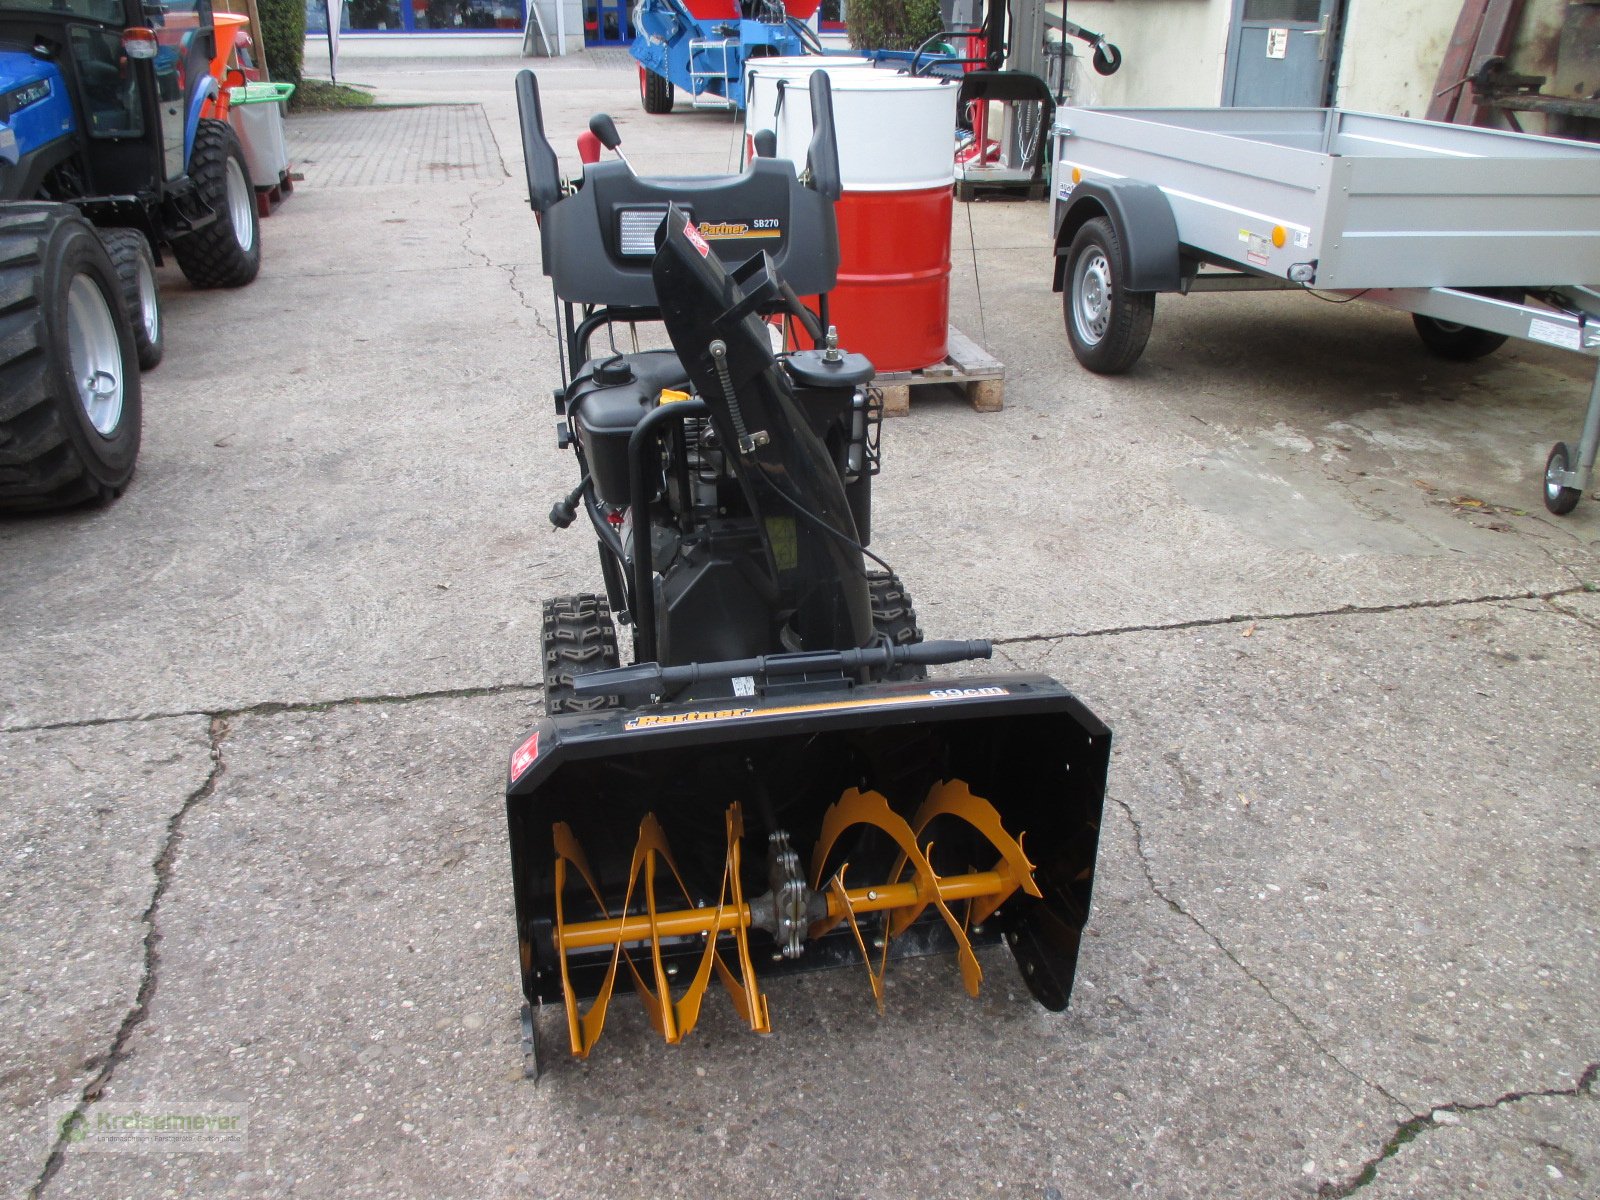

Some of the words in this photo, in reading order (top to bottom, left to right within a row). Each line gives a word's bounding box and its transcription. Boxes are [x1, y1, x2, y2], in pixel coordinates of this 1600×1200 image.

[698, 222, 748, 236] Partner
[754, 219, 779, 228] SB270
[628, 708, 753, 727] Partner
[930, 687, 1004, 699] 69cm
